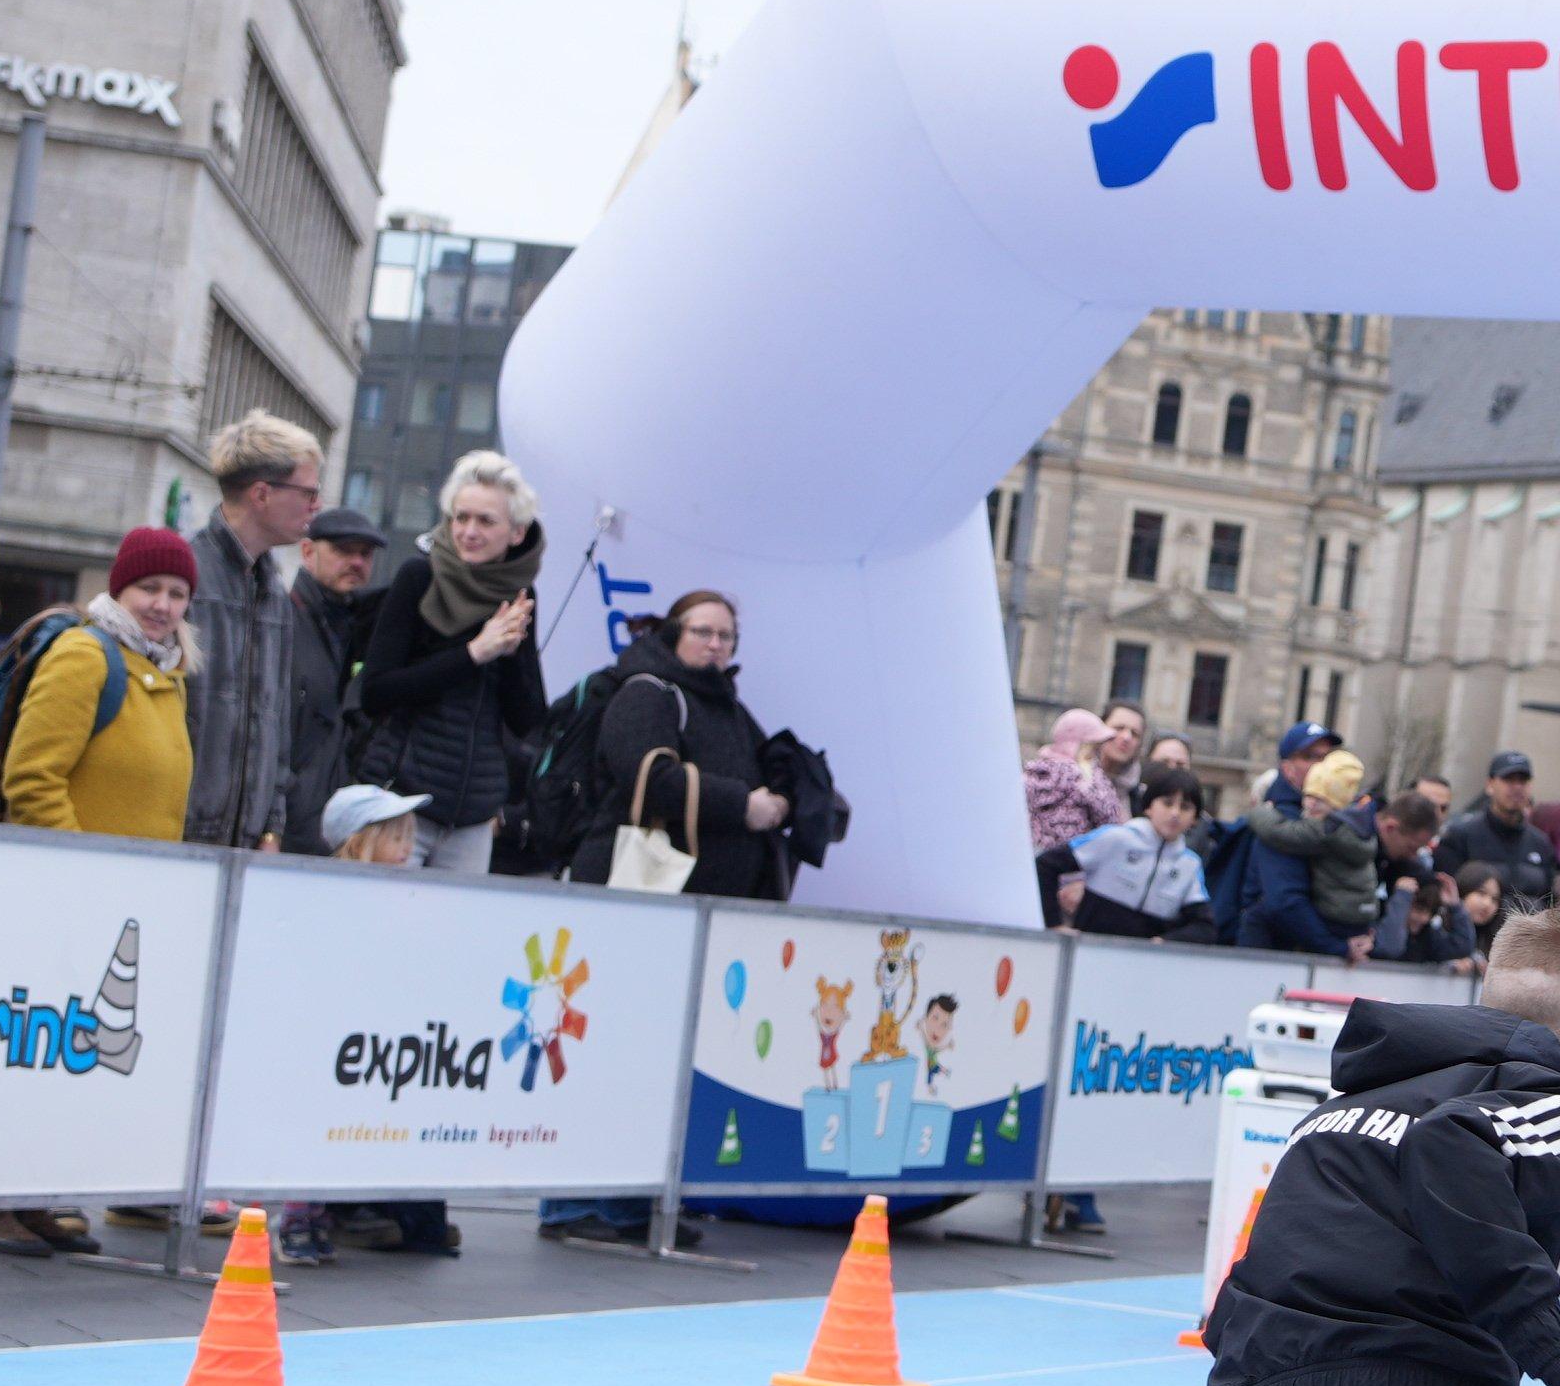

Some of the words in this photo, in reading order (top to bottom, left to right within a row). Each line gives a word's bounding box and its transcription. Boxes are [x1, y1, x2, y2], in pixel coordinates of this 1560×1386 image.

[334, 1020, 493, 1102] expika
[1070, 1020, 1255, 1105] Kindersprin
[327, 1123, 411, 1142] entdecken
[419, 1123, 478, 1143] erleben
[488, 1124, 559, 1148] begreifen
[875, 1079, 892, 1139] 1
[1357, 1108, 1422, 1147] HA
